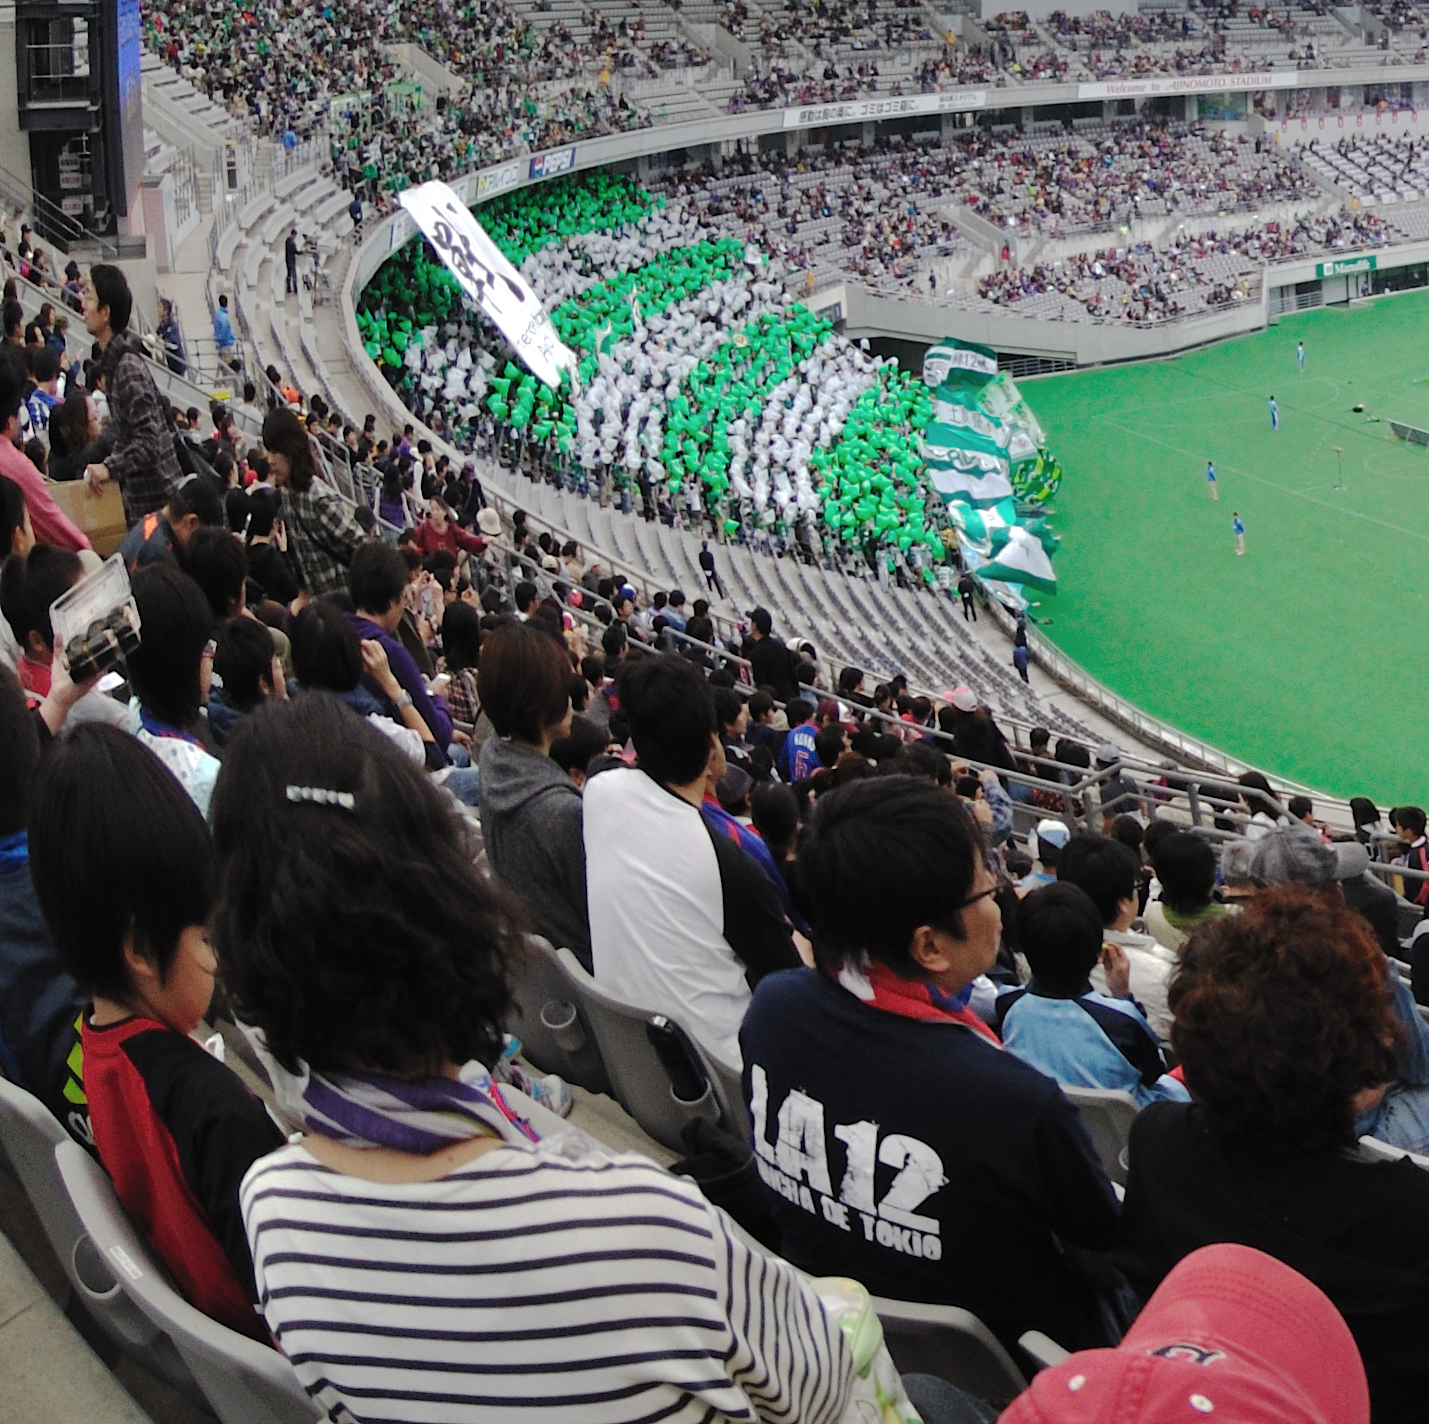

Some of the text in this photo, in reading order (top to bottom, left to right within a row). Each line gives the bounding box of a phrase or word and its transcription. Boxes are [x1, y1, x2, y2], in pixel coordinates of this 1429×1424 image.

[1106, 76, 1273, 94] Welcome to AJINOMOTO STADIUM
[542, 150, 574, 175] PEPSI
[750, 1063, 950, 1234] LA 12
[820, 1194, 851, 1232] DE
[859, 1212, 942, 1261] TOKIO
